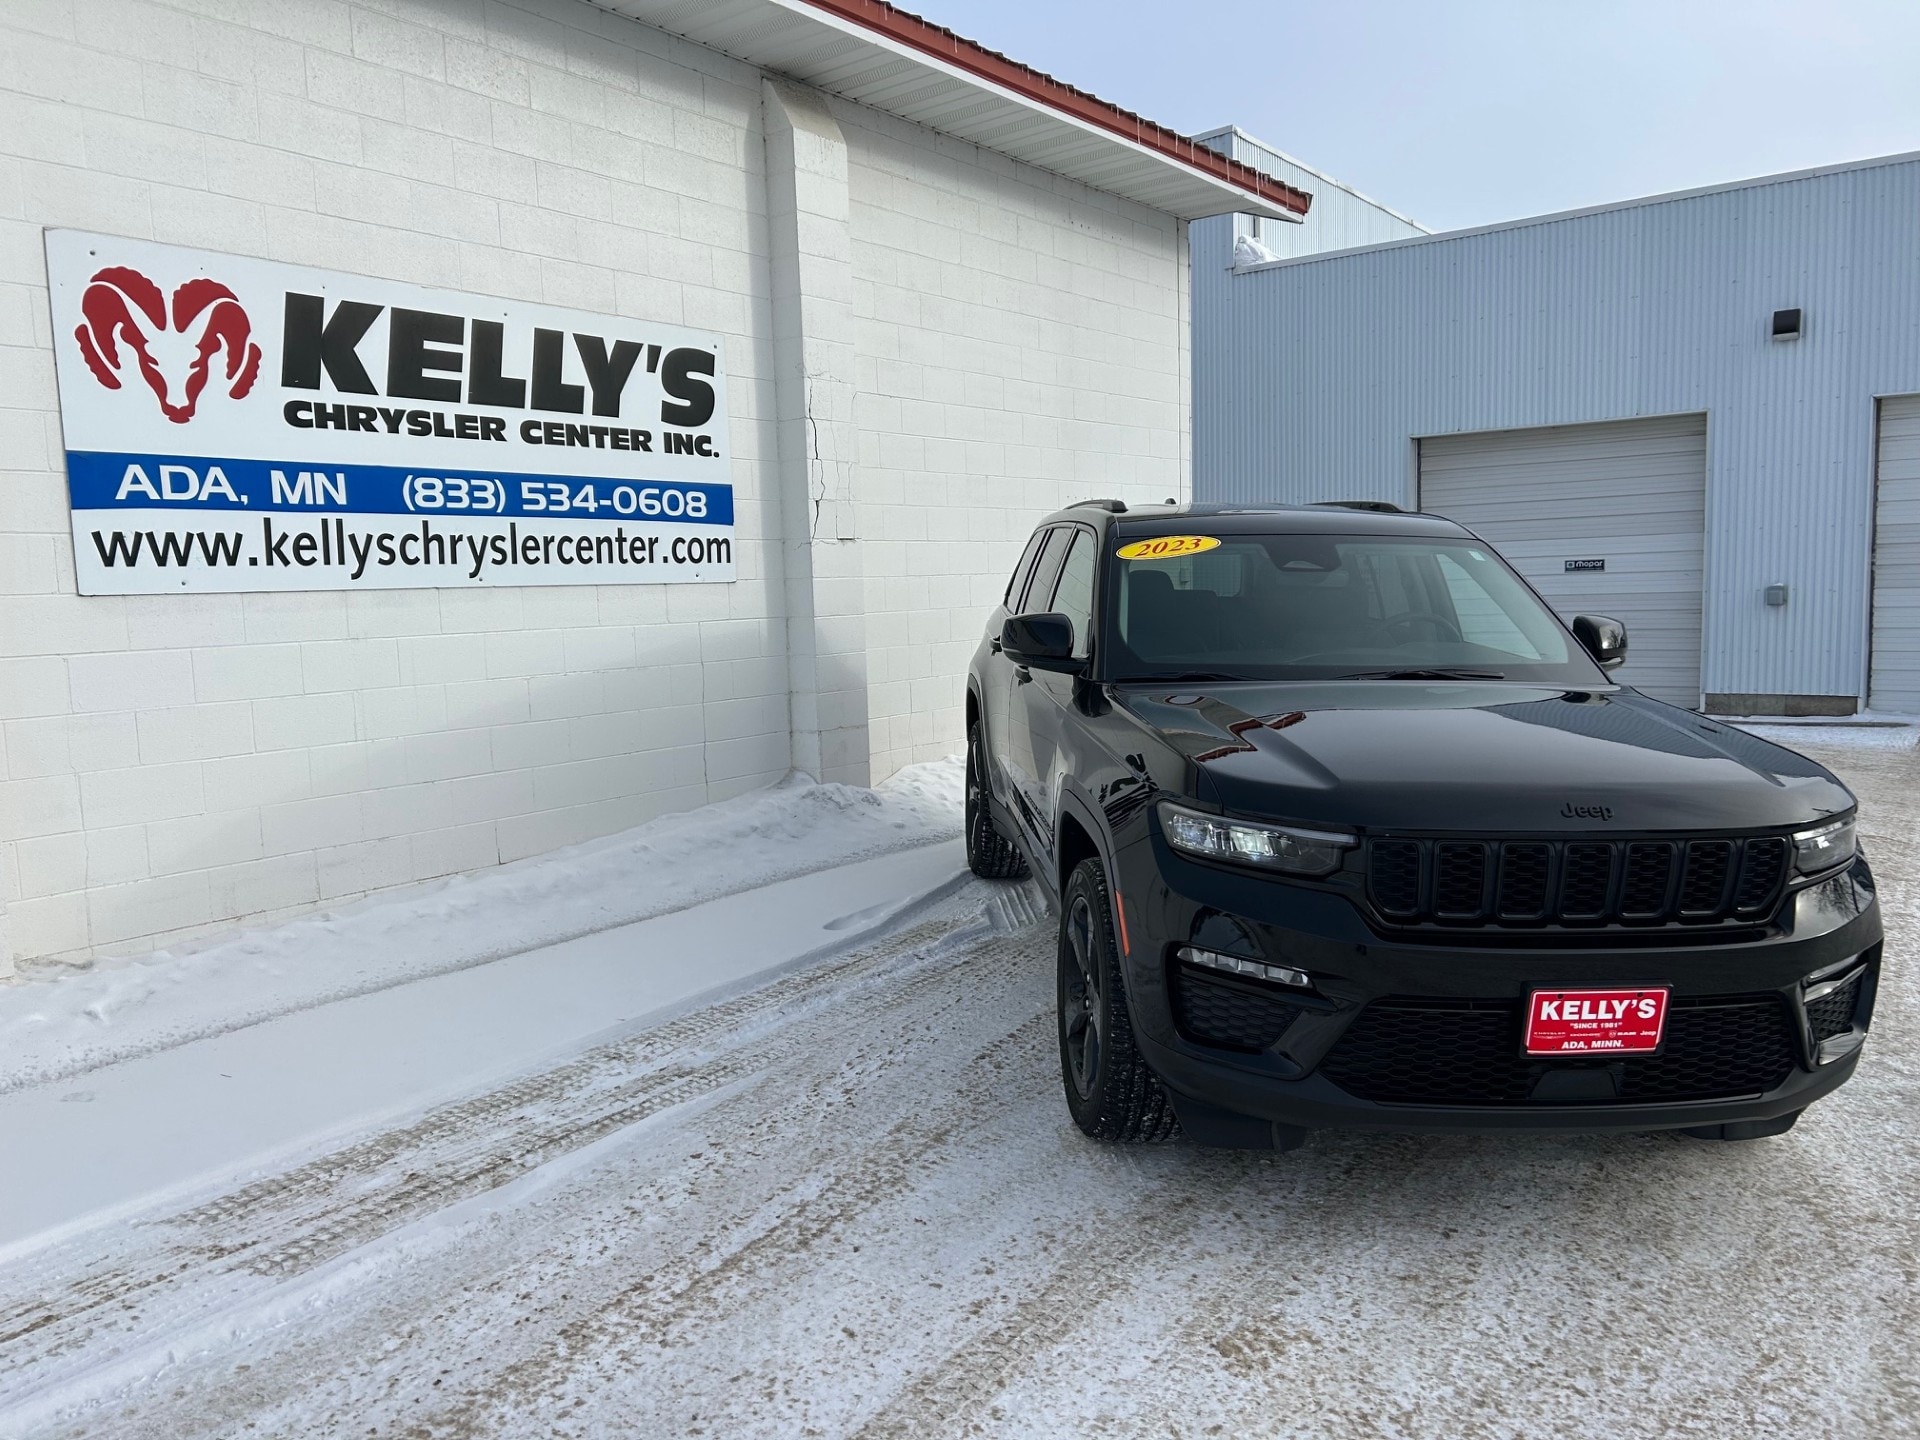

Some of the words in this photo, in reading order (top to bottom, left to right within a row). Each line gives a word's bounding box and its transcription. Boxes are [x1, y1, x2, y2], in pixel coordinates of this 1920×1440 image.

[281, 291, 716, 428] KELLY'S
[283, 400, 508, 442] CHRYSLER
[519, 419, 653, 453] CENTER
[663, 431, 720, 458] INC.
[115, 463, 249, 506] ADA,
[270, 470, 348, 506] MN
[402, 474, 507, 513] (833)
[520, 481, 708, 518] 534-0608
[91, 516, 732, 581] www.kellyschryslercenter.com
[1134, 538, 1202, 557] 2023
[1560, 802, 1614, 821] Jeep
[1540, 998, 1656, 1021] KELLY'S
[1561, 1040, 1588, 1050] ADA,
[1591, 1039, 1625, 1049] MINN.
